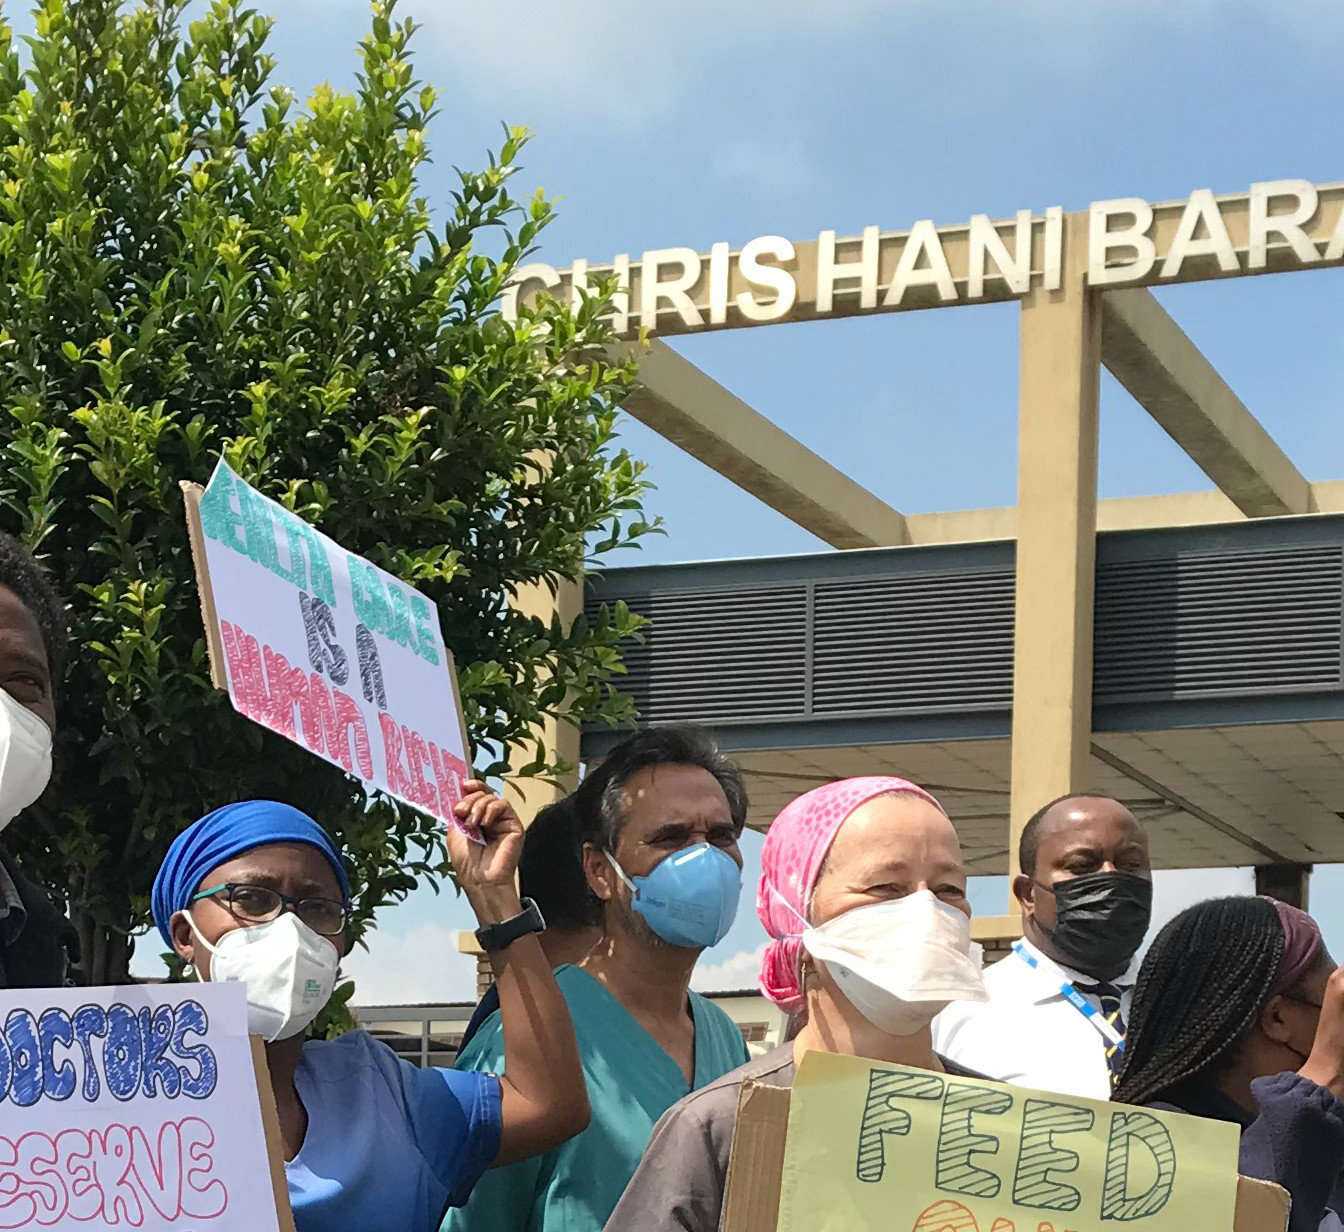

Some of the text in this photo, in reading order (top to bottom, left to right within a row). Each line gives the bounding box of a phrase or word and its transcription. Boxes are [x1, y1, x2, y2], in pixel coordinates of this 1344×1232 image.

[501, 234, 796, 338] CHRIS
[814, 206, 1063, 312] HANI
[220, 619, 374, 781] HUMAN
[298, 590, 388, 711] IS A
[856, 1068, 1177, 1222] FEED
